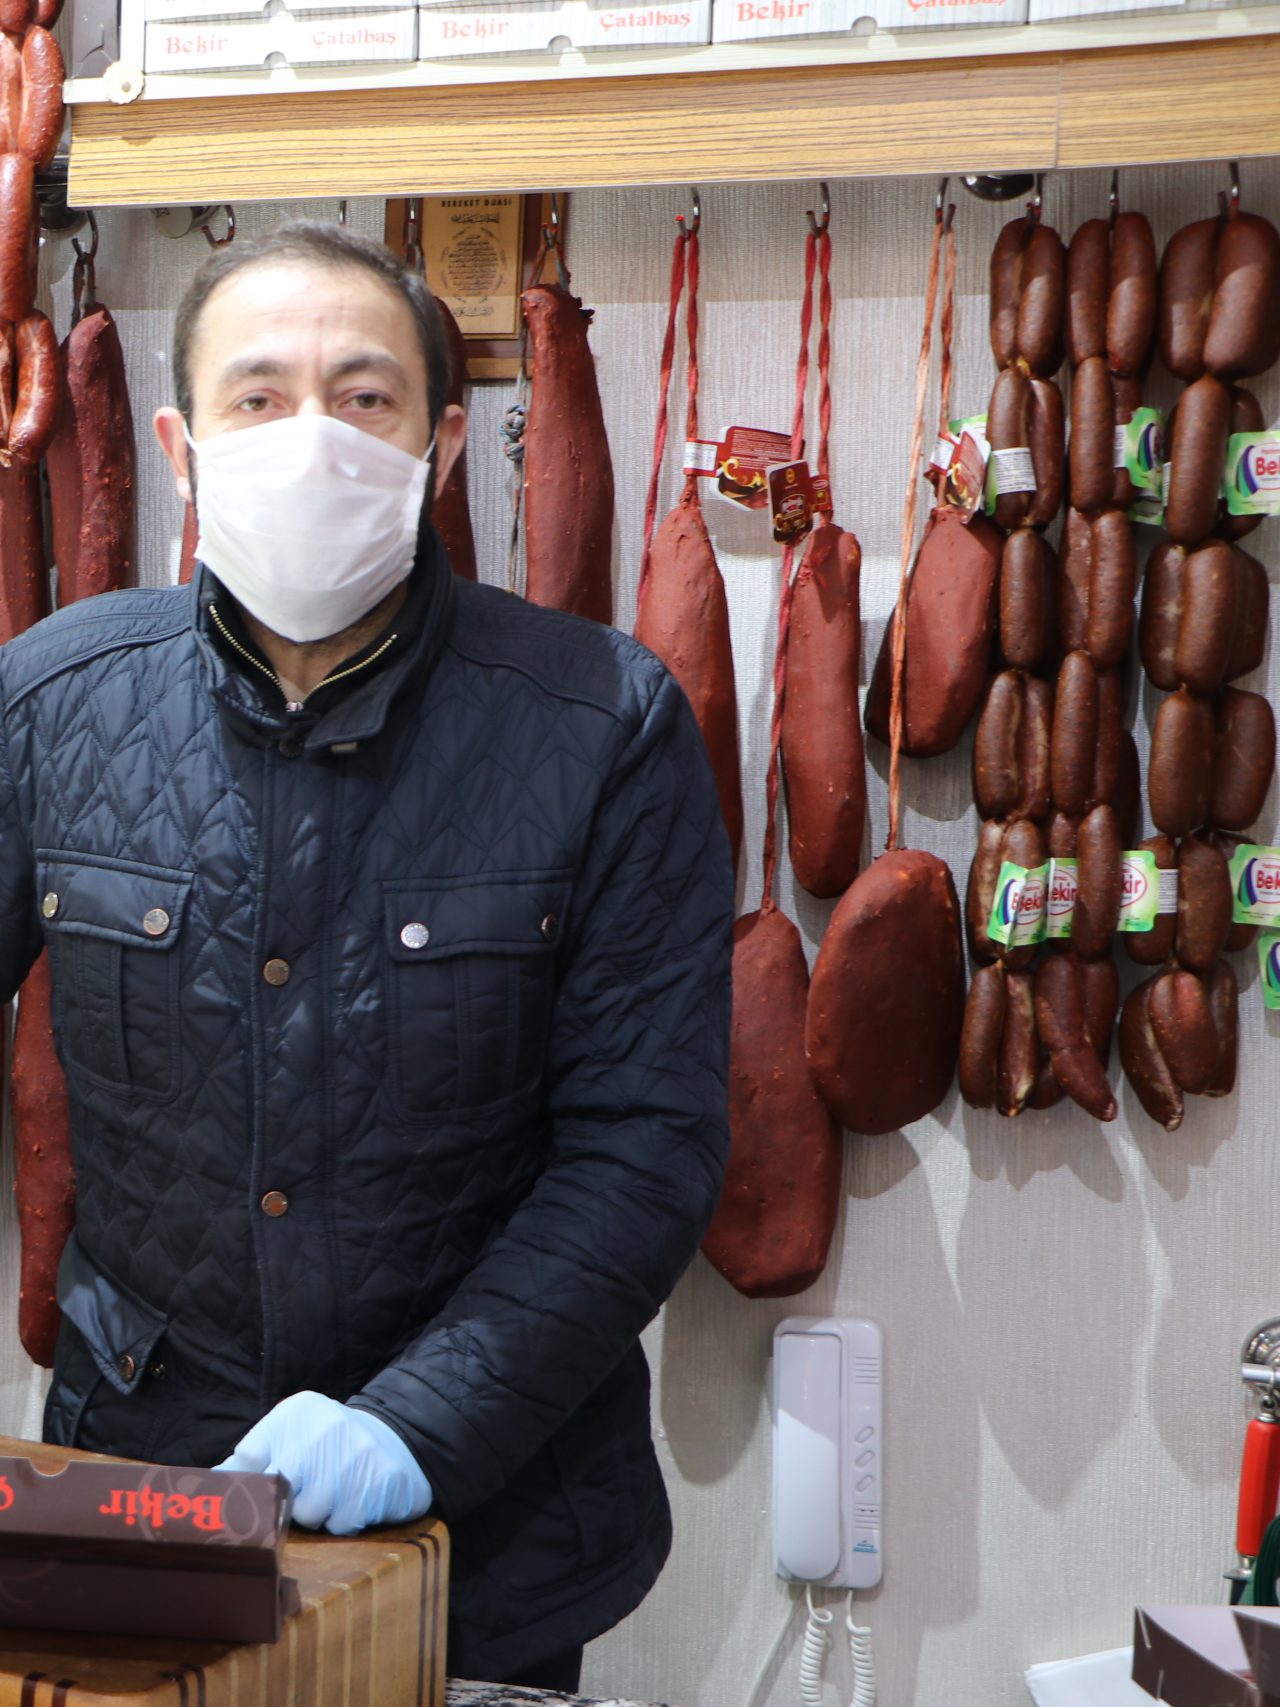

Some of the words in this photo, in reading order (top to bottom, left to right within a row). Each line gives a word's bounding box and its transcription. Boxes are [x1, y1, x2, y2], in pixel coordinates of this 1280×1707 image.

[600, 11, 691, 31] Çatalbaş
[312, 29, 397, 48] Çatalbaş
[99, 1484, 225, 1531] Bekir
